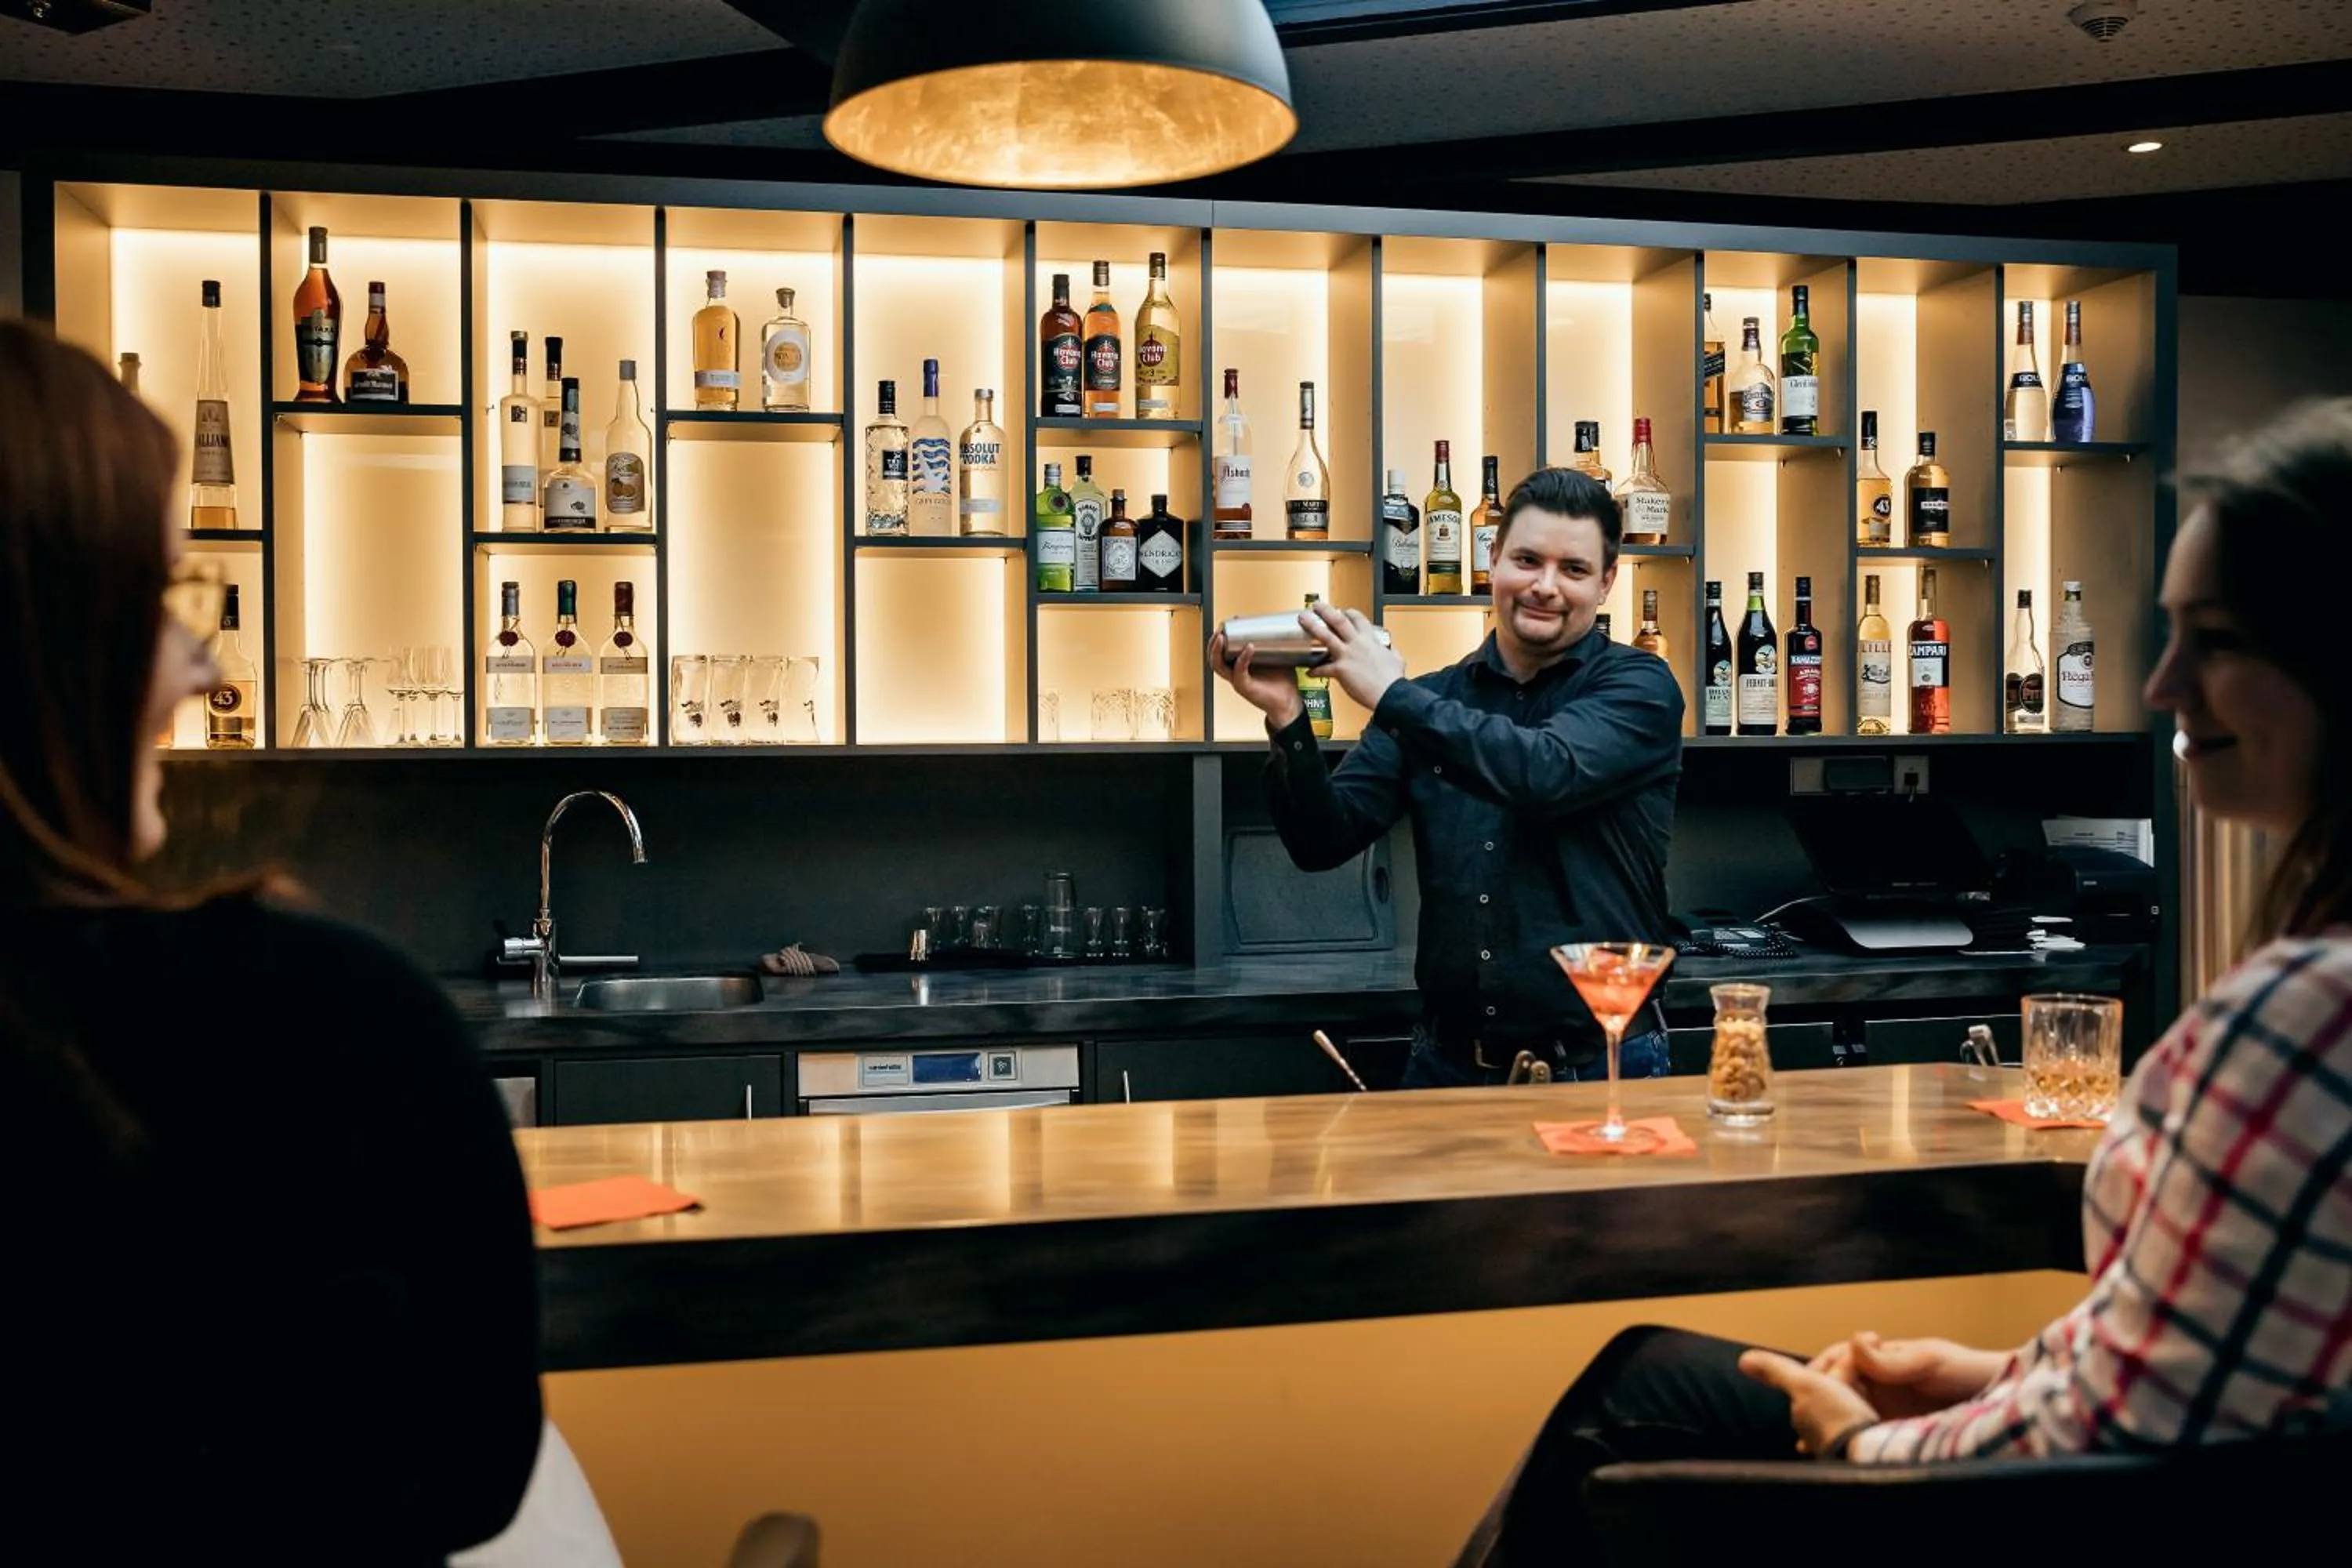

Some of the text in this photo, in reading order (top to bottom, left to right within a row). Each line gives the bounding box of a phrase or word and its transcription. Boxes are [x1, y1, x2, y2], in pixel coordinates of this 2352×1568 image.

[1142, 353, 1161, 361] Club
[961, 454, 996, 465] VODKA
[213, 690, 234, 705] 43
